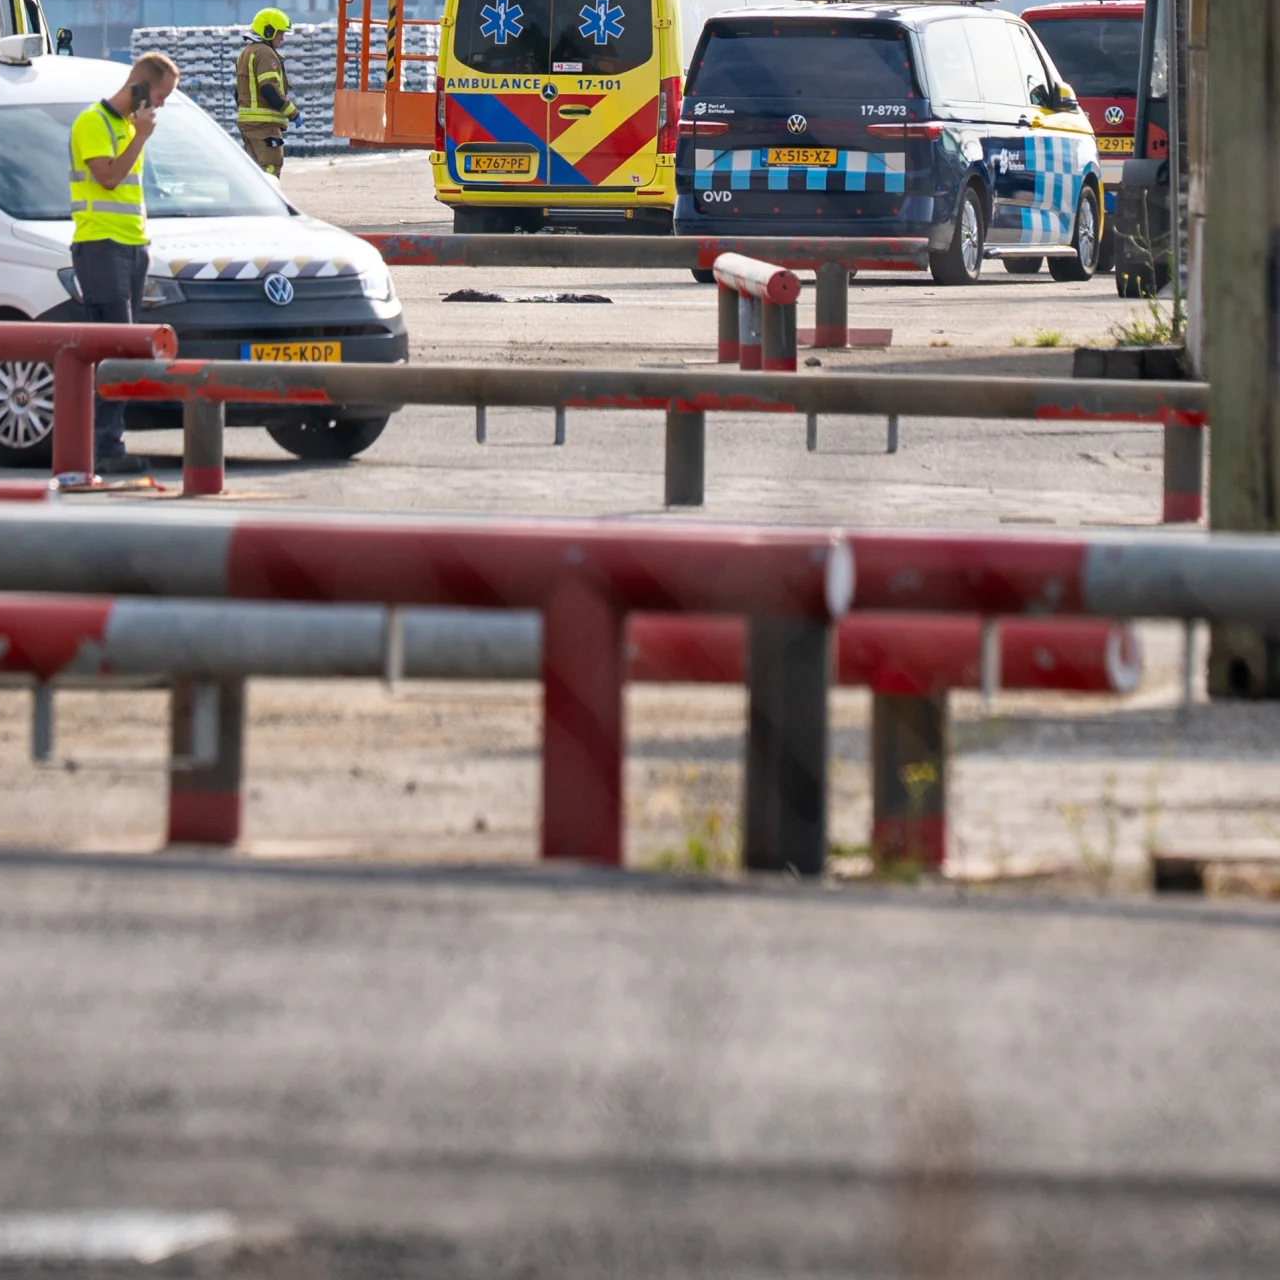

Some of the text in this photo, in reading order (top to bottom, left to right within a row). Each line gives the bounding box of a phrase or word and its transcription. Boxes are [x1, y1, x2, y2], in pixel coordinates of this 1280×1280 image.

[447, 77, 541, 90] AMBULANCE
[577, 79, 621, 91] 17-101
[860, 105, 907, 116] 17-8793
[475, 157, 524, 169] K-767-PF
[773, 150, 831, 163] X-515-XZ
[703, 190, 732, 203] OVD
[254, 344, 334, 362] V-75-KDP
